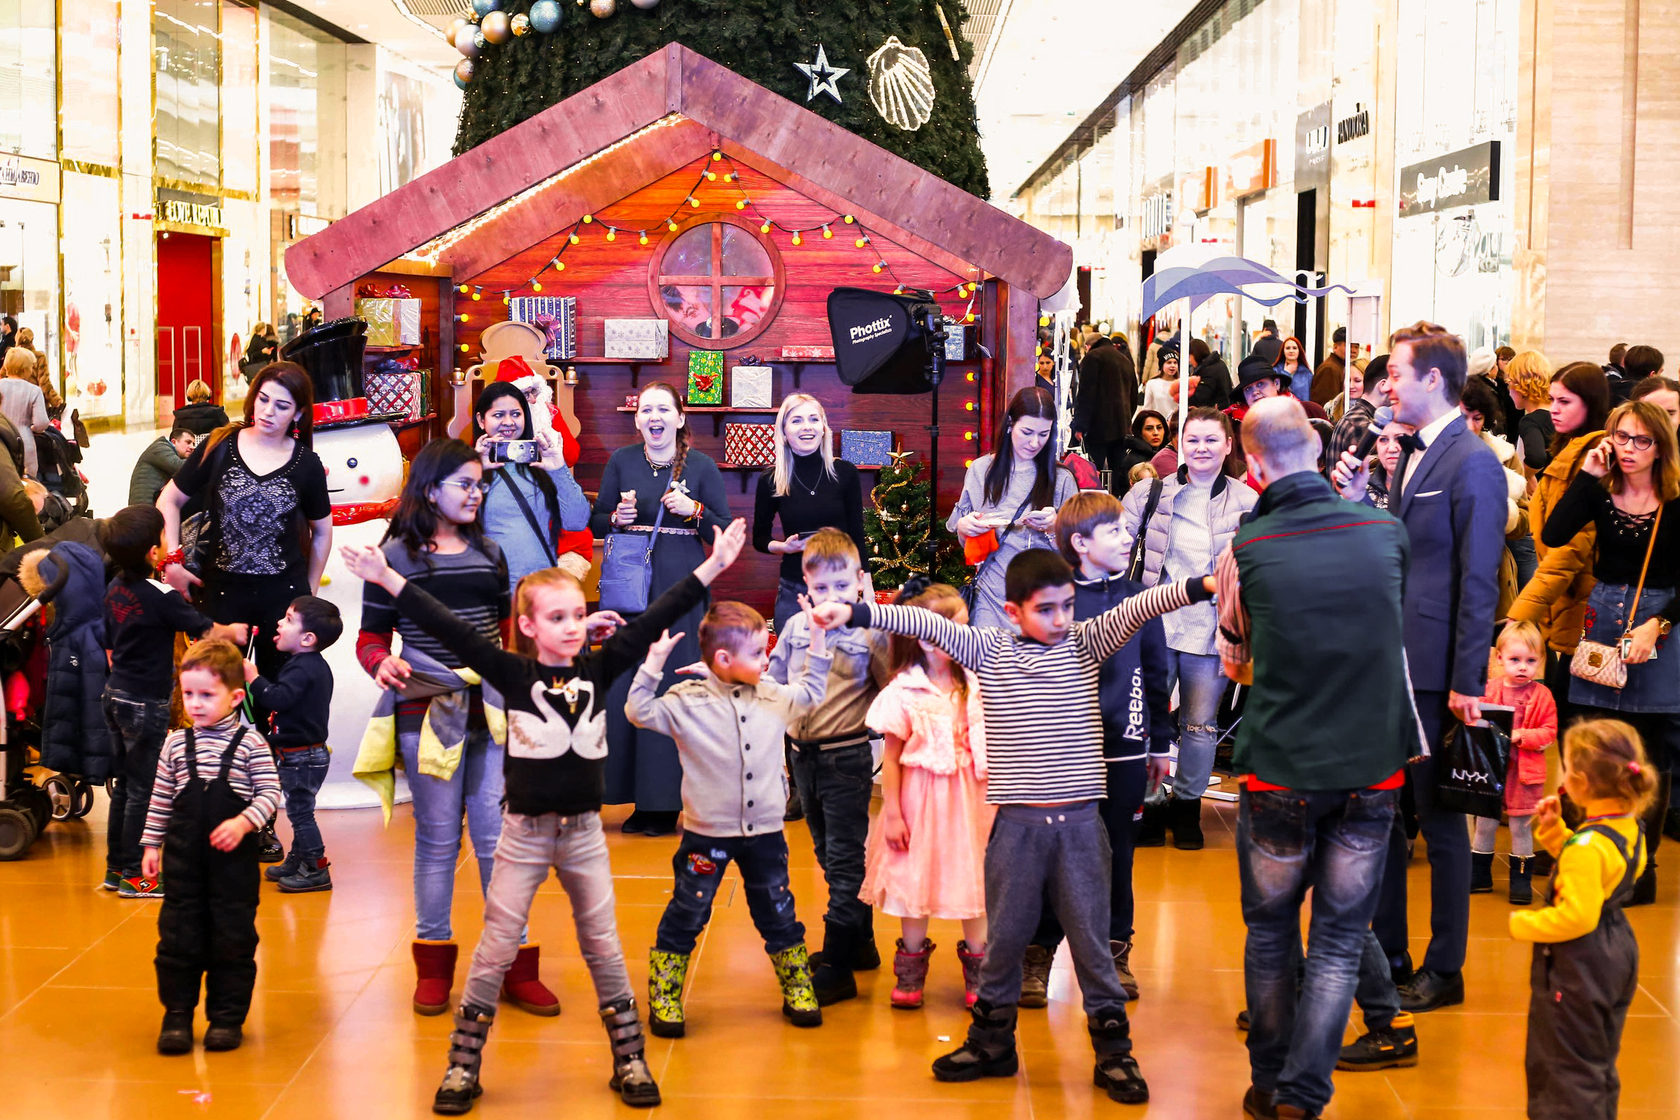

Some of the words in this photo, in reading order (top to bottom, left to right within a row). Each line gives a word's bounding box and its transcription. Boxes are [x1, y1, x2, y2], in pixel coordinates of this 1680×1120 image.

[1337, 109, 1369, 145] PANDORA
[850, 317, 891, 339] Phottix
[1451, 768, 1489, 784] NYX
